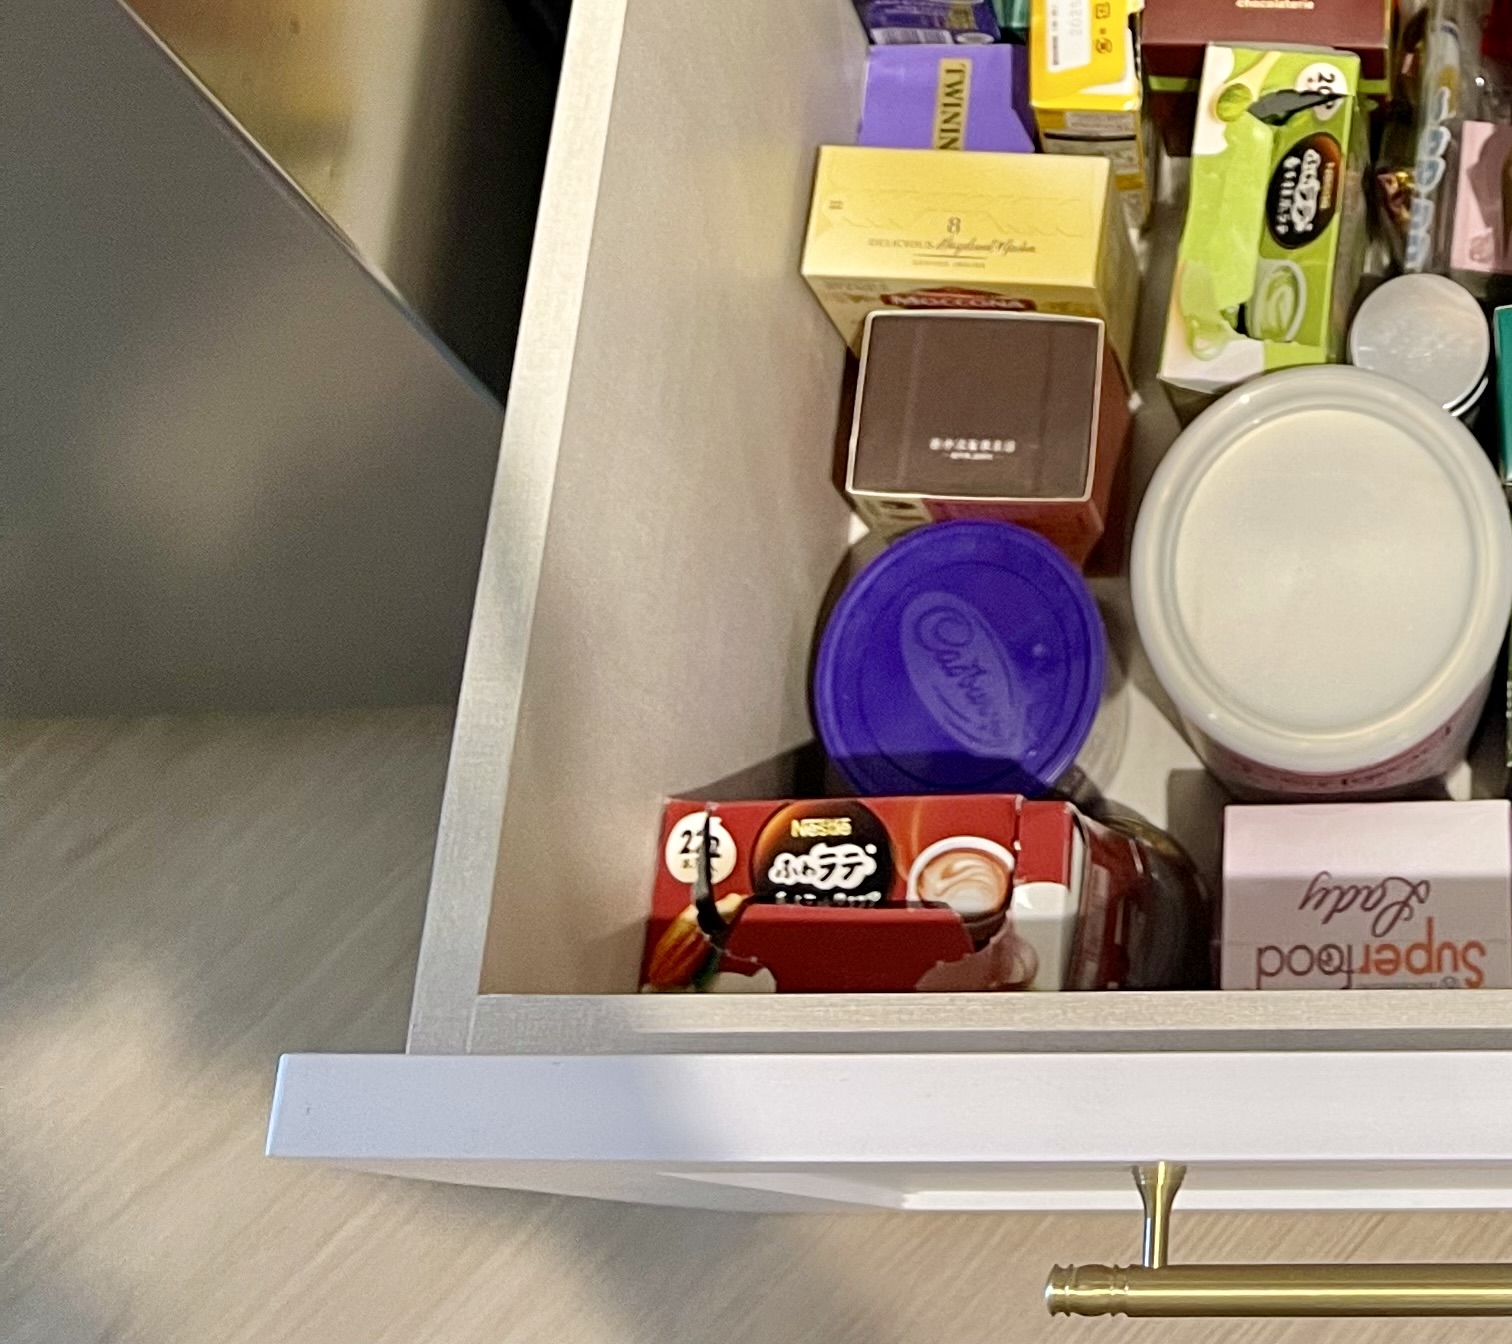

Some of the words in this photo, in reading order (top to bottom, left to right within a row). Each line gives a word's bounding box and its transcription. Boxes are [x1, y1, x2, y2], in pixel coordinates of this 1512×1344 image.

[771, 849, 867, 884] ふわラテ
[1299, 870, 1431, 938] Lady
[1256, 916, 1487, 990] Superfood
